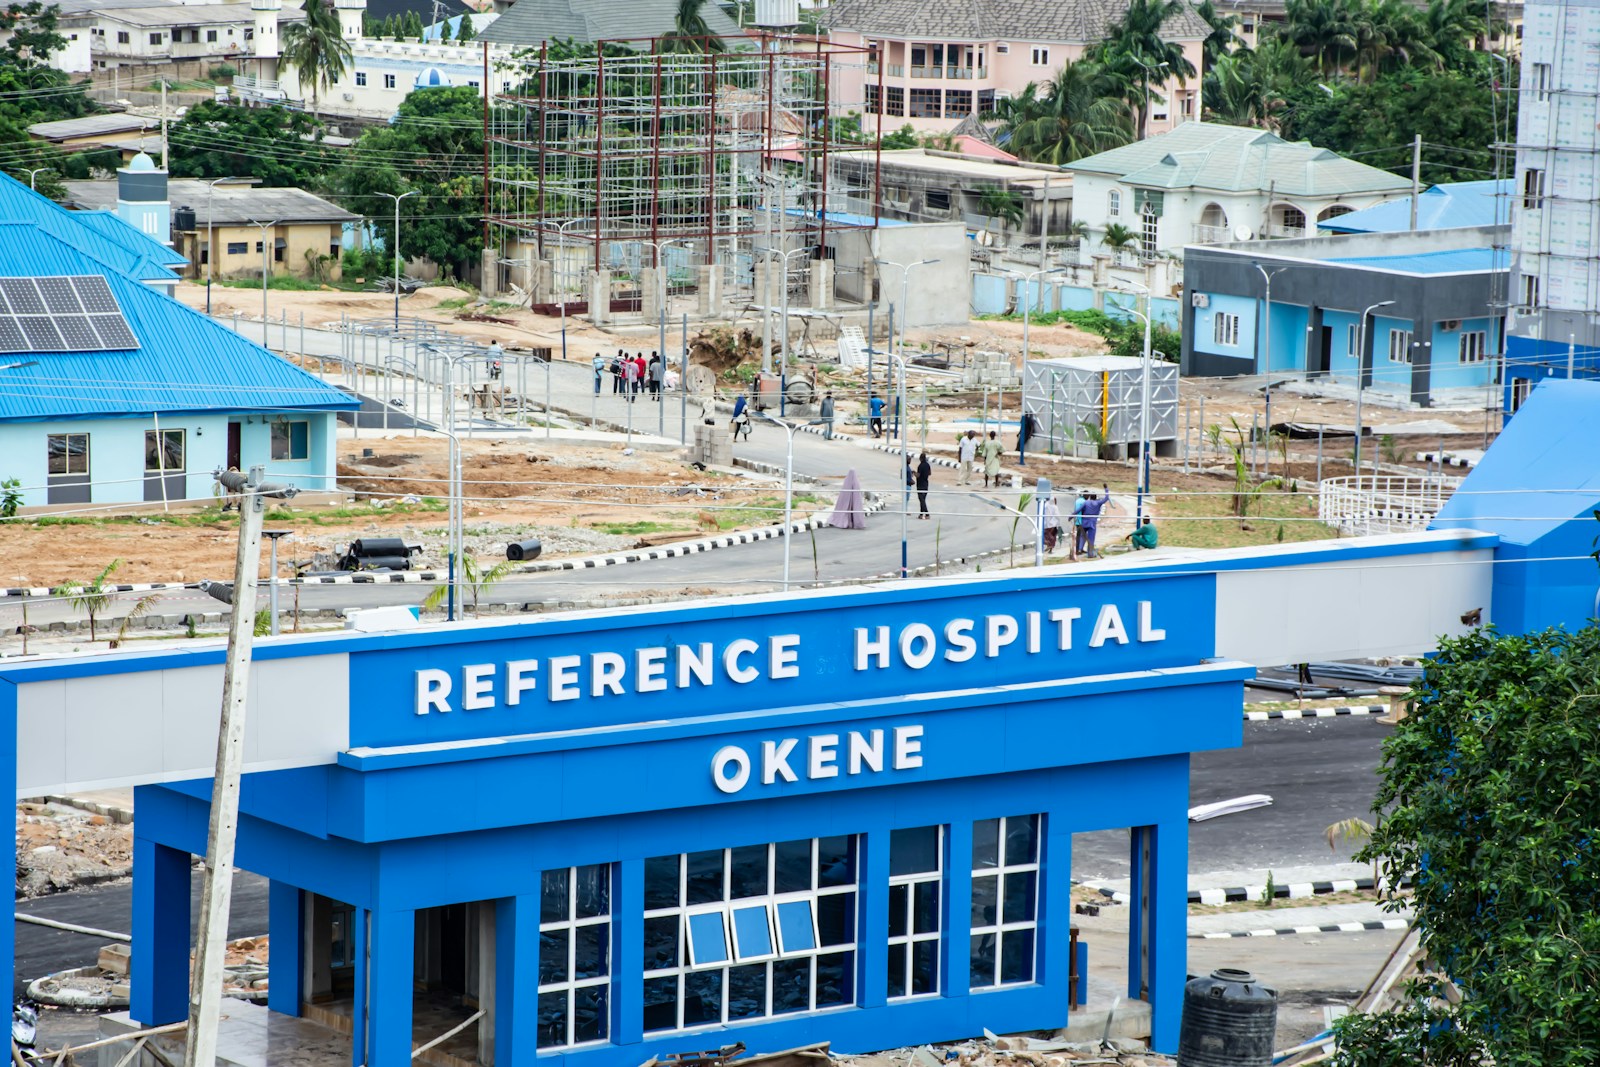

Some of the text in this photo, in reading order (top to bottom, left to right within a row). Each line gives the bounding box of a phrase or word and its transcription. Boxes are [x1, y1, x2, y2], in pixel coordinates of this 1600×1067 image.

[414, 600, 1166, 715] REFERENCE HOSPITAL
[710, 725, 924, 795] OKENE
